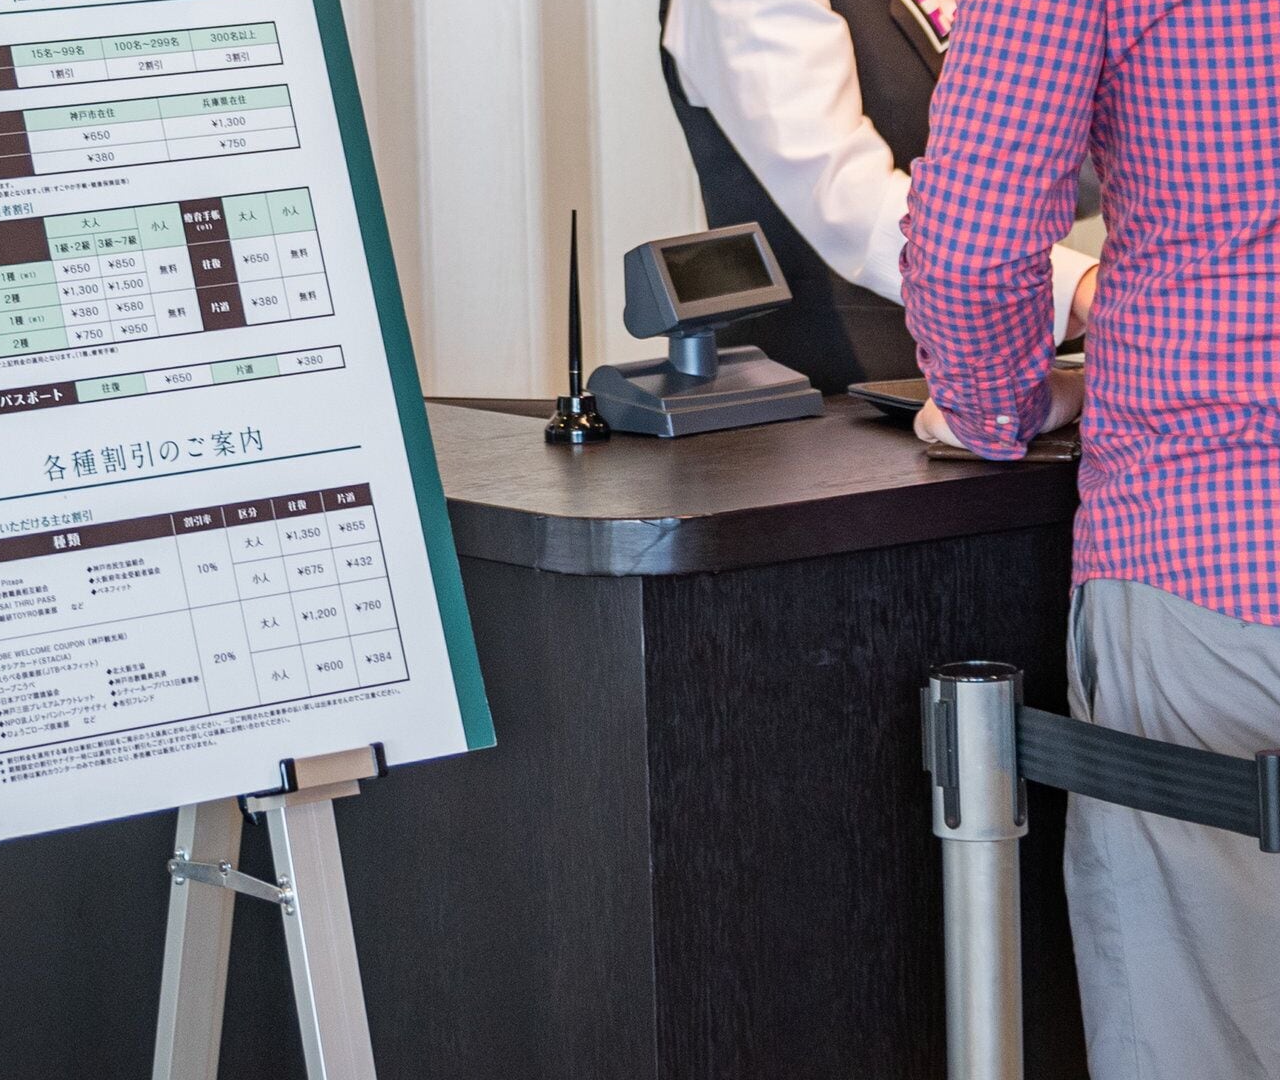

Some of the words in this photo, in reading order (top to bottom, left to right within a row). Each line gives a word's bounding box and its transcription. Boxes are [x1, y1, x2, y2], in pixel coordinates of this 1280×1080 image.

[209, 29, 257, 43] 300名以上
[225, 51, 250, 62] 3割引
[137, 59, 163, 71] 2割引
[50, 67, 74, 79] 1割引
[69, 107, 115, 121] 神戸市在住
[210, 115, 246, 128] ¥1,300
[82, 129, 111, 141] ¥650
[218, 137, 246, 149] ¥750
[86, 151, 115, 163] ¥380
[238, 210, 257, 222] 大人
[281, 205, 300, 217] 小人
[81, 216, 101, 229] 大人
[150, 220, 169, 232] 小人
[242, 252, 270, 264] ¥650
[290, 247, 308, 258] 無料
[61, 262, 91, 274] ¥650
[107, 257, 136, 269] ¥850
[158, 263, 177, 274] 無料
[0, 271, 16, 282] 1種
[62, 283, 99, 296] ¥1,300
[107, 277, 144, 291] ¥1,500
[3, 292, 20, 304] 2種
[250, 295, 278, 307] ¥380
[298, 290, 317, 301] 無料
[70, 305, 99, 317] ¥380
[115, 300, 144, 312] ¥580
[167, 306, 186, 318] 無料
[9, 315, 24, 326] 1種
[74, 328, 103, 340] ¥750
[120, 322, 148, 335] ¥950
[12, 337, 29, 349] 2種
[296, 354, 324, 366] ¥380
[235, 363, 254, 375] 片道
[164, 371, 193, 384] ¥650
[101, 381, 120, 393] 往復
[44, 425, 263, 482] 各種割引のご案内
[287, 499, 307, 512] 往復
[237, 506, 257, 520] 区分
[182, 513, 212, 528] 割引率
[337, 519, 366, 533] ¥855
[284, 526, 321, 541] ¥1,350
[52, 532, 81, 549] 種類
[244, 535, 263, 548] 大人
[345, 555, 373, 568] ¥432
[196, 562, 218, 574] 10%
[296, 563, 324, 576] ¥675
[252, 571, 271, 585] 小人
[13, 598, 35, 608] THRU
[36, 594, 57, 604] PASS
[354, 599, 382, 612] ¥760
[300, 606, 337, 621] ¥1,200
[260, 616, 280, 629] 大人
[13, 644, 51, 658] WELCOME
[365, 650, 392, 664] ¥384
[213, 651, 237, 664] 20%
[315, 659, 344, 672] ¥600
[271, 668, 290, 681] 小人
